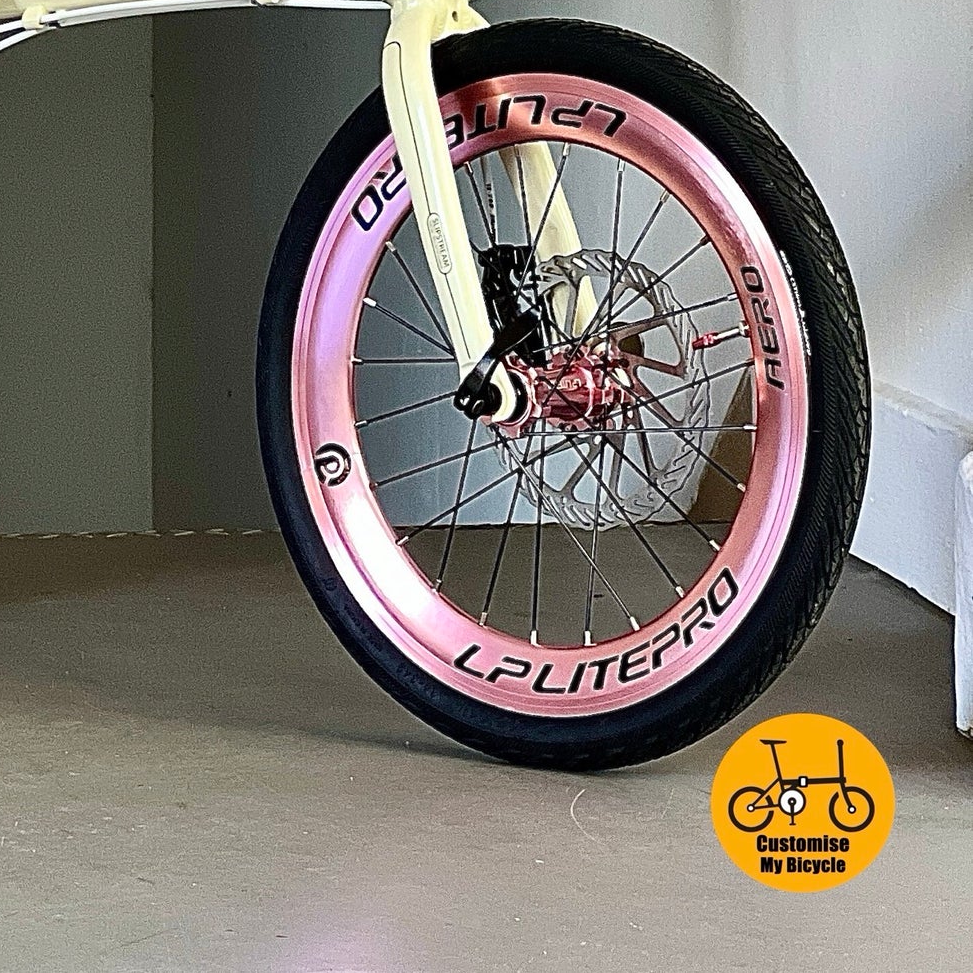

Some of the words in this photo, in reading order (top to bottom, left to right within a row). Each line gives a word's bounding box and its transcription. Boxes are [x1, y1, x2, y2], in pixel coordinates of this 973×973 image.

[351, 94, 628, 232] LPLITERO
[432, 217, 450, 268] SLIPSTREAM
[740, 266, 785, 390] AERO
[453, 566, 739, 695] LPLITEPRO
